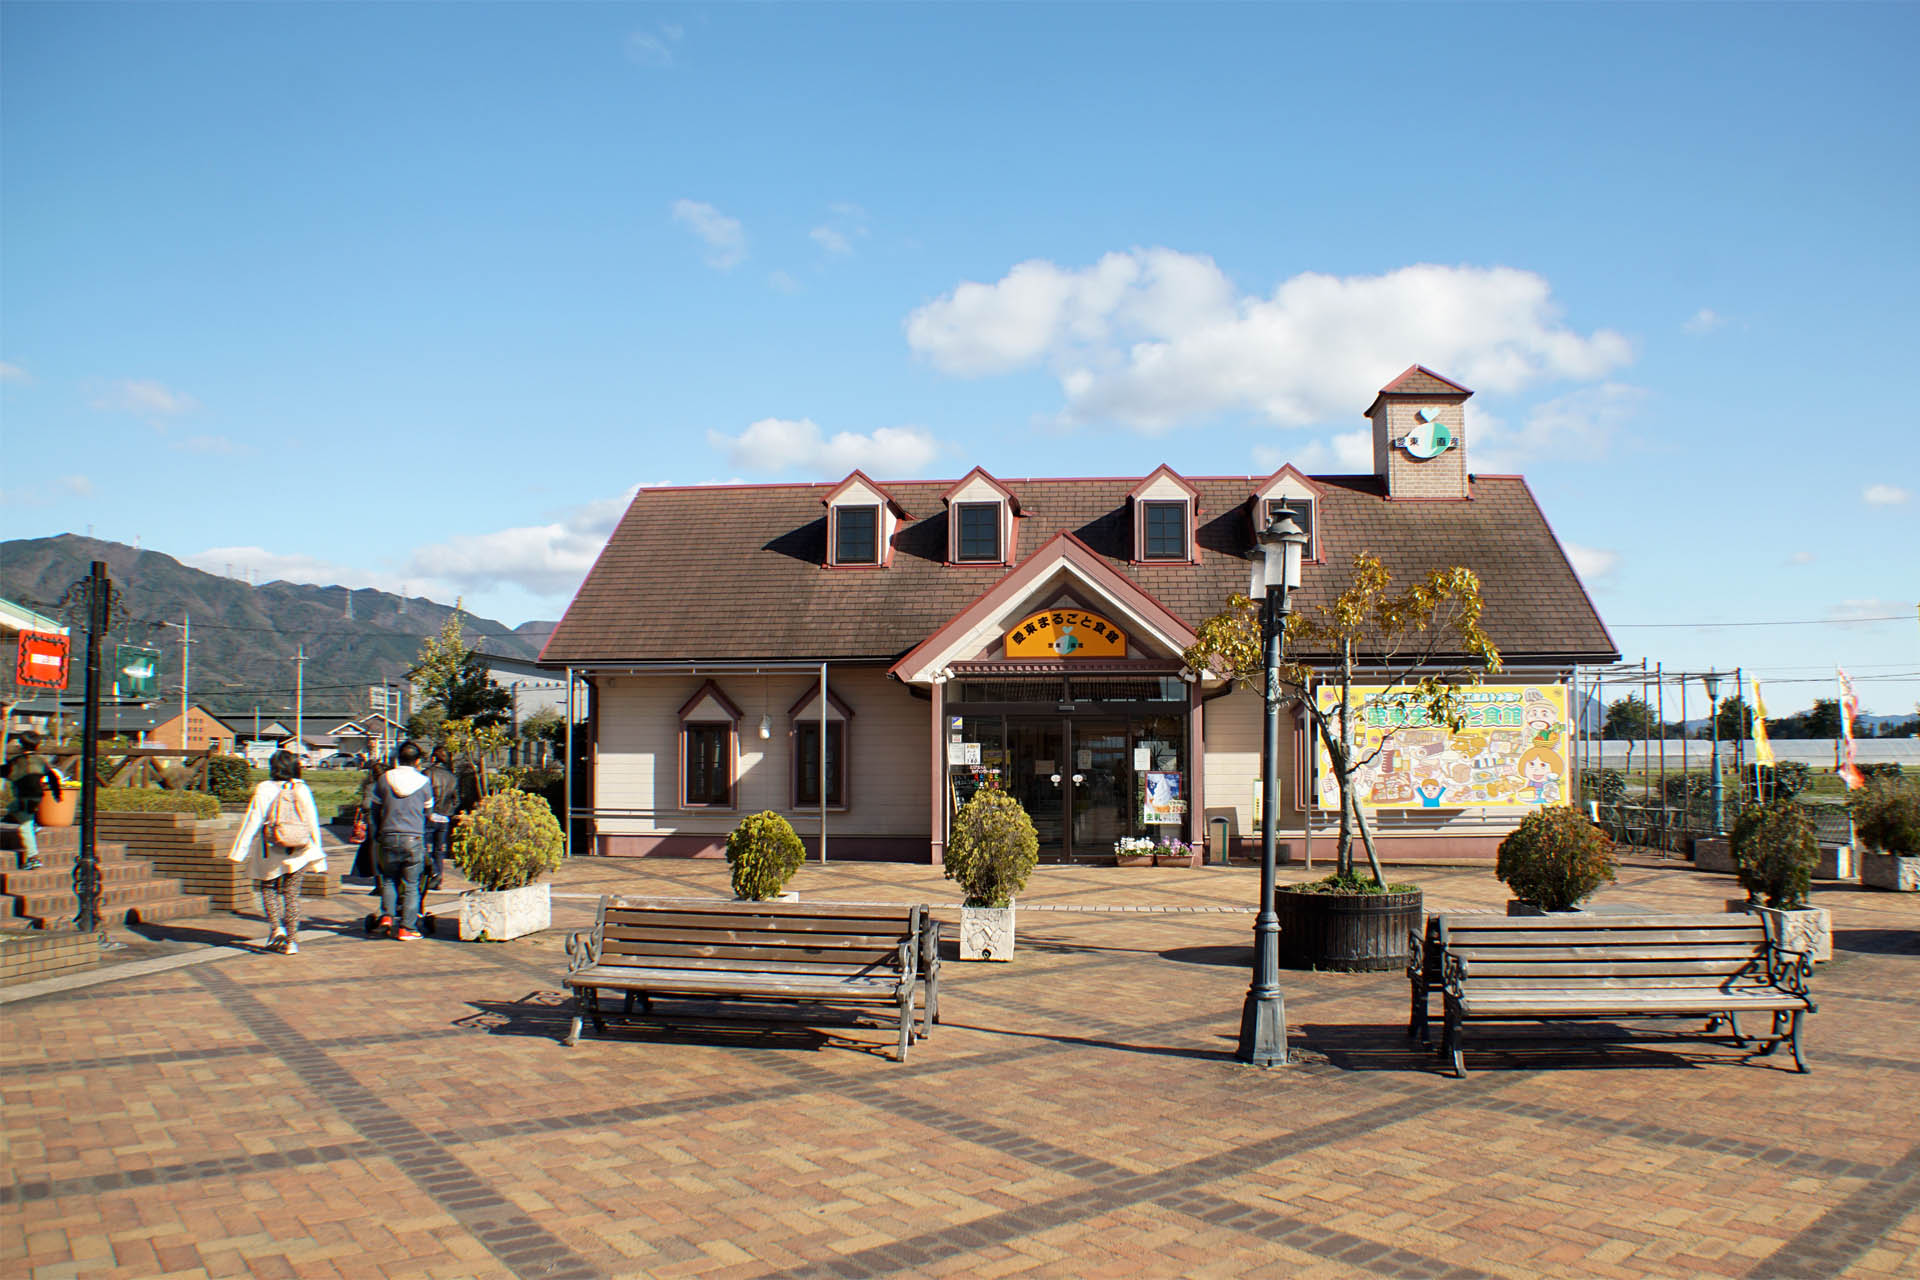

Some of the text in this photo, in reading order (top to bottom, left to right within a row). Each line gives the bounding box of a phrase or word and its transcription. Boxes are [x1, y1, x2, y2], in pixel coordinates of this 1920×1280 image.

[1012, 613, 1119, 645] 愛東まるごと食館
[1367, 706, 1521, 726] 愛東まと食館
